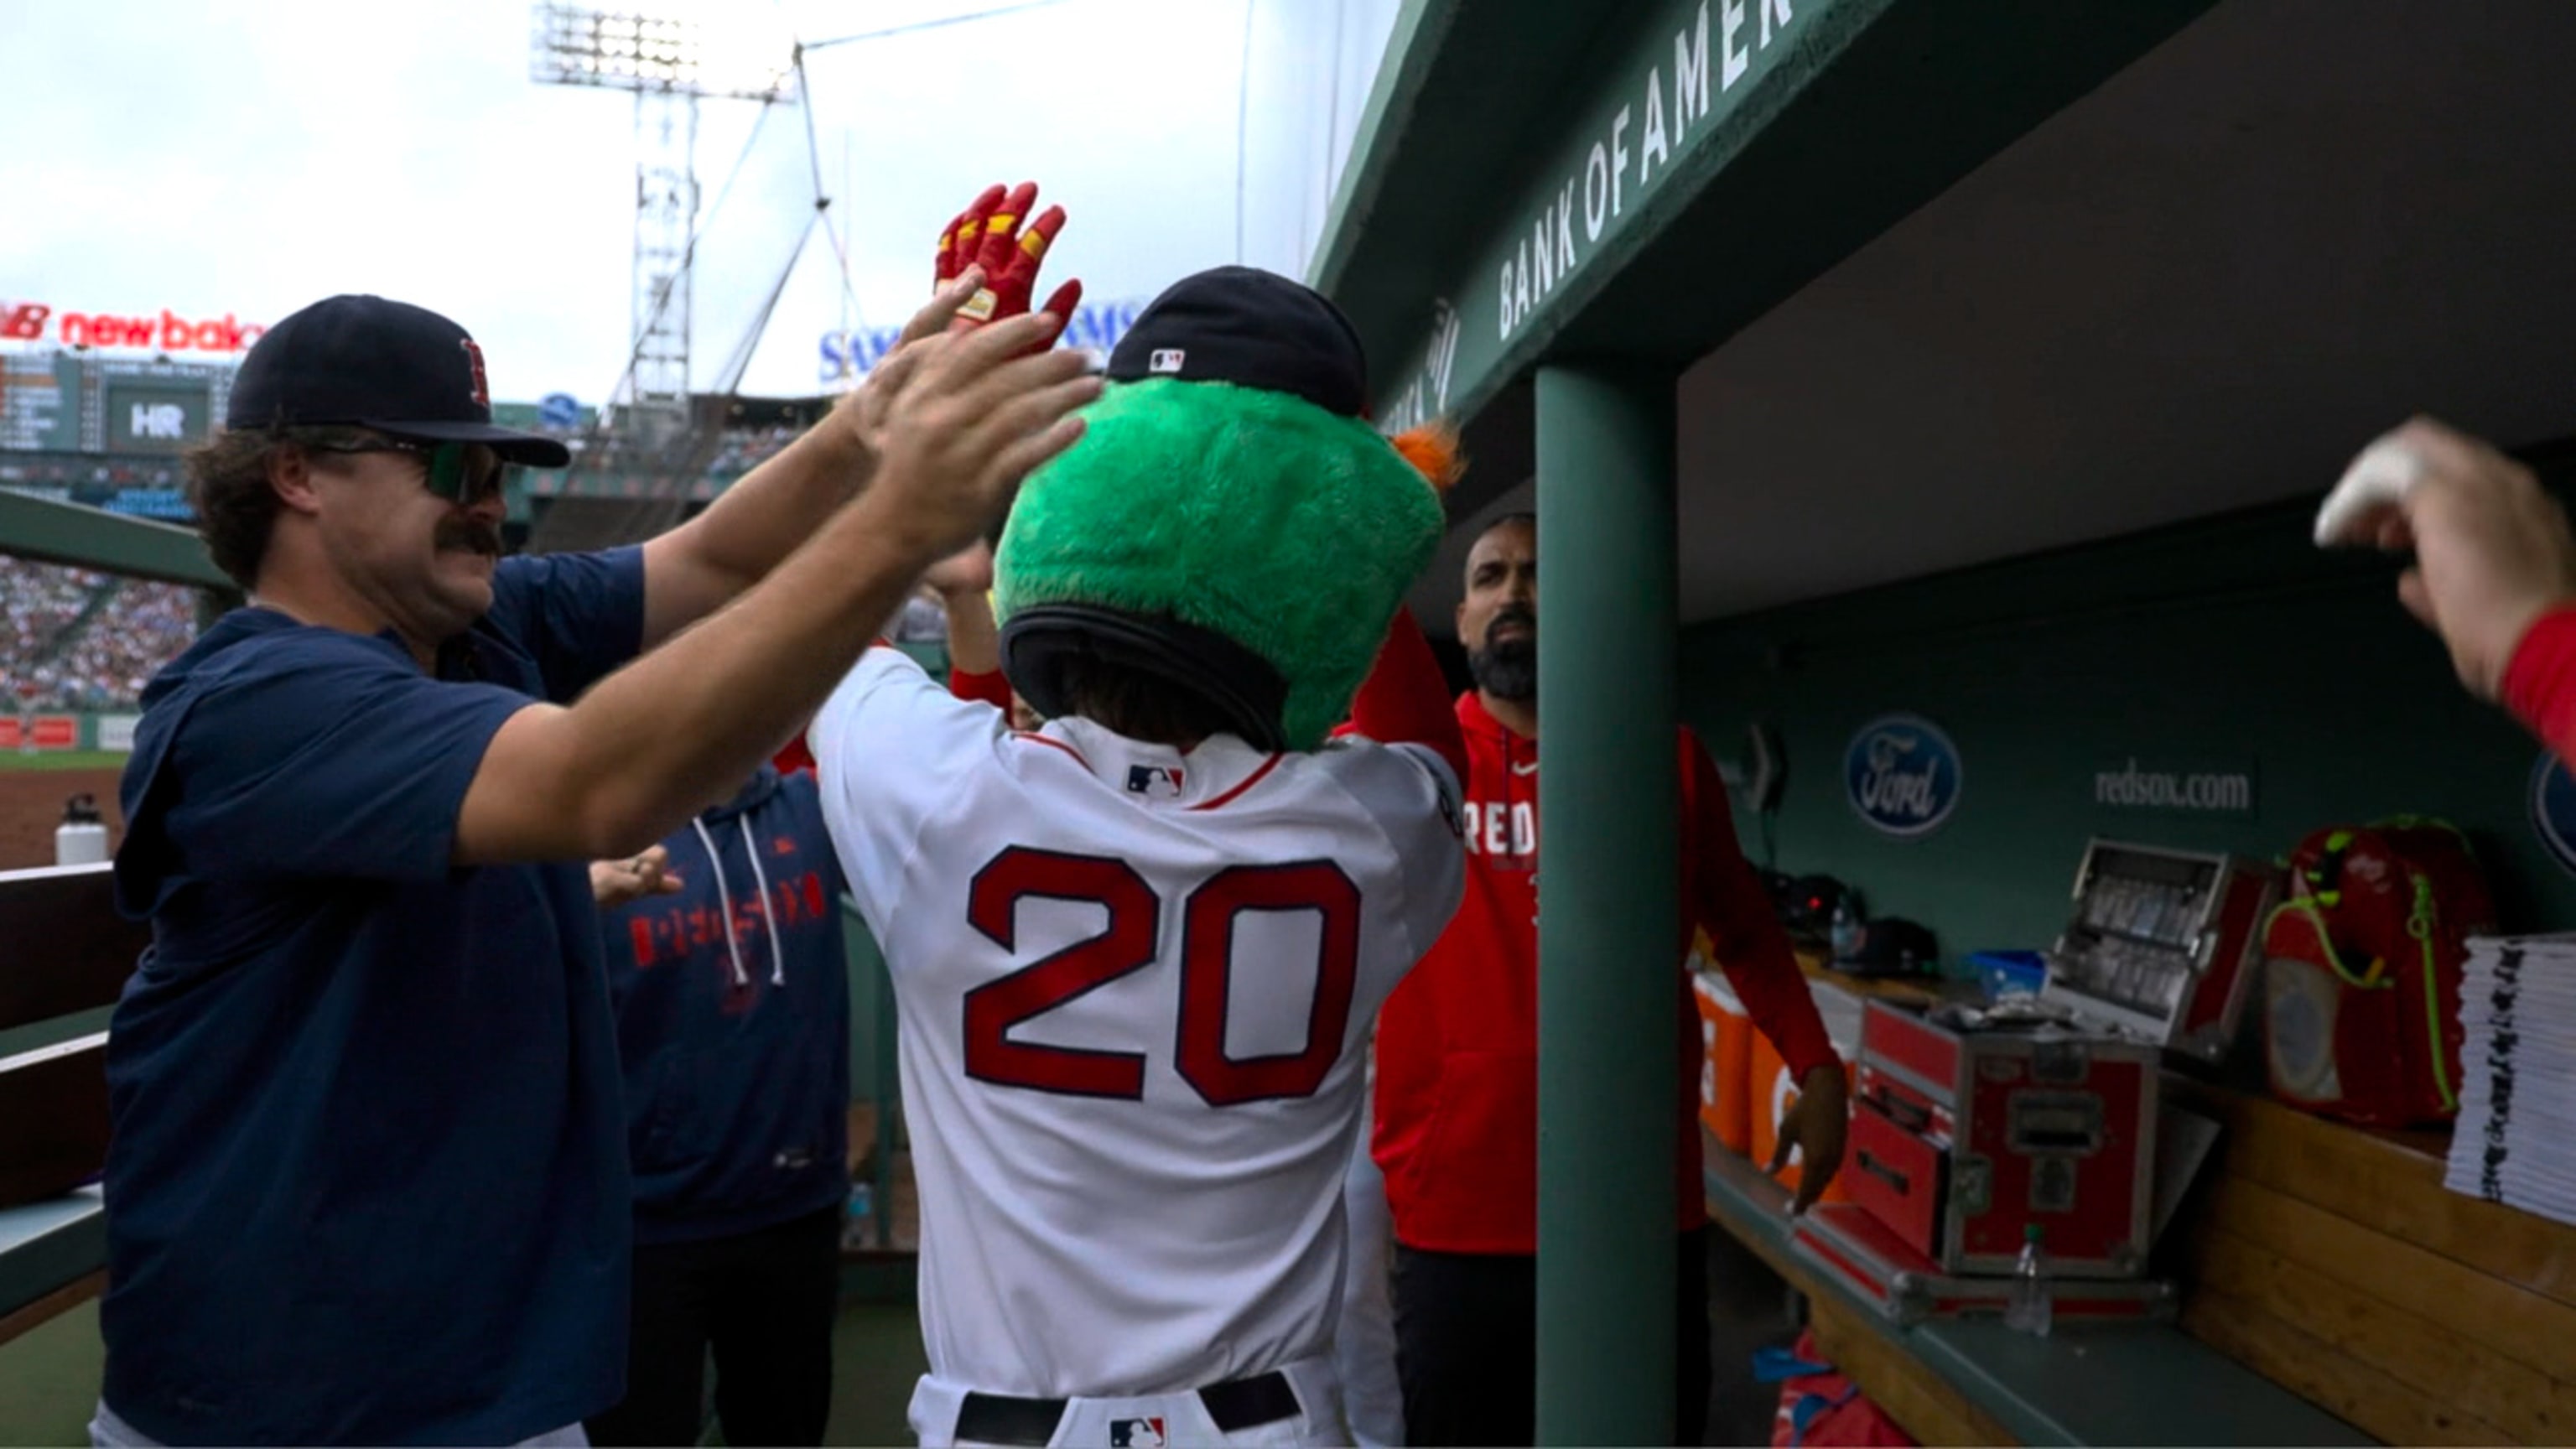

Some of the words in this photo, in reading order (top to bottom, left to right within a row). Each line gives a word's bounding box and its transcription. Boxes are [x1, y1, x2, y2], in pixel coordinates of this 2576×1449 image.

[1499, 177, 1577, 342] BANK
[1584, 104, 1631, 242] OF
[60, 313, 154, 346] new
[131, 403, 184, 437] HR
[1860, 732, 1939, 818] Ford
[2095, 756, 2251, 809] redsox.com
[1463, 801, 1536, 855] RED
[963, 844, 1362, 1107] 20
